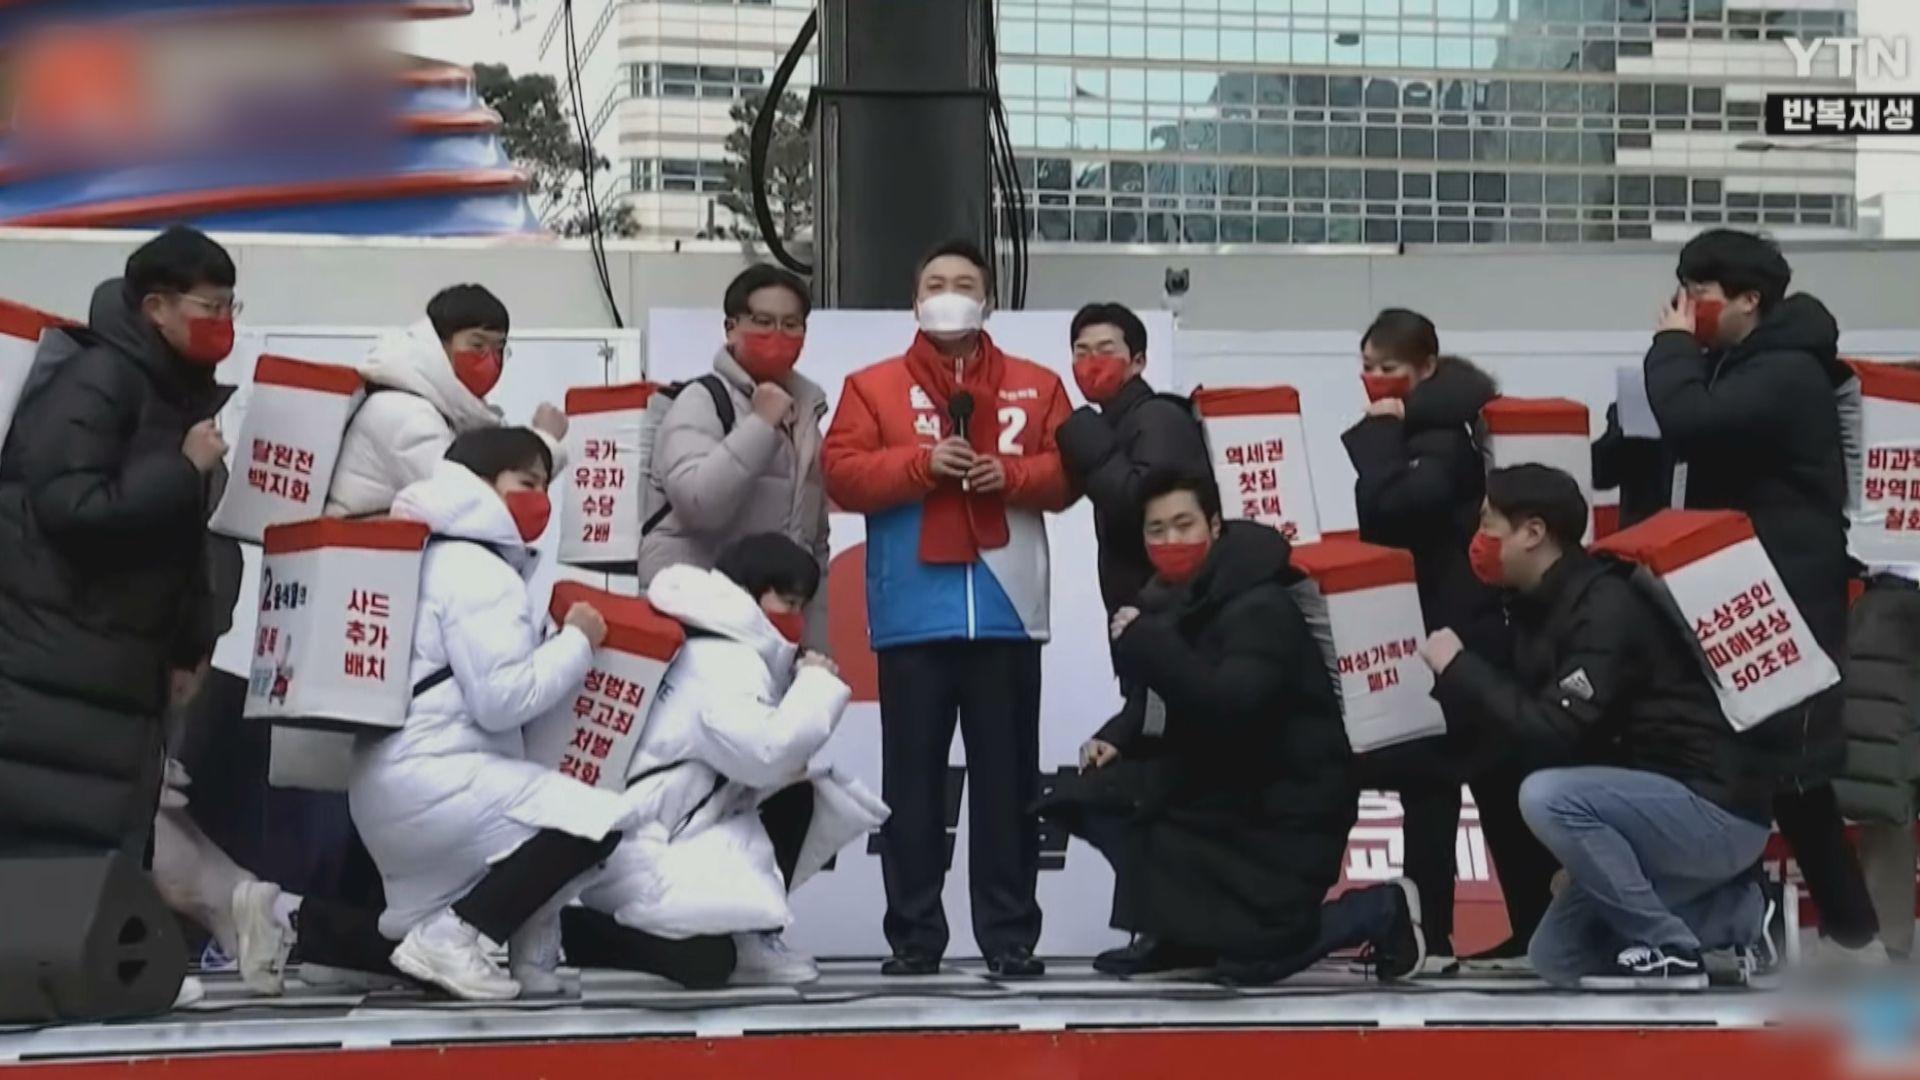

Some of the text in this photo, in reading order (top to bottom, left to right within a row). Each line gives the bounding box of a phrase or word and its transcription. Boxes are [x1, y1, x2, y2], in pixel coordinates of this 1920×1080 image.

[997, 406, 1027, 456] 2
[252, 438, 315, 475] 탈원전
[584, 439, 618, 462] 국가
[1225, 438, 1285, 466] 역세권
[248, 467, 310, 504] 백지화
[575, 467, 625, 490] 유공자
[582, 495, 615, 518] 수당
[1242, 495, 1282, 521] 주택
[581, 522, 611, 543] 2배
[261, 565, 273, 612] 2
[347, 588, 390, 618] 사드
[1694, 579, 1776, 641] 소상공인
[345, 619, 389, 650] 추가
[1705, 609, 1792, 669] 피해보상
[344, 651, 387, 682] 배치
[1336, 637, 1418, 674] 여성가족부
[1731, 637, 1802, 692] 50조원
[584, 665, 646, 709] 성범죄
[572, 695, 636, 736] 무고죄
[568, 726, 614, 759] 처벌
